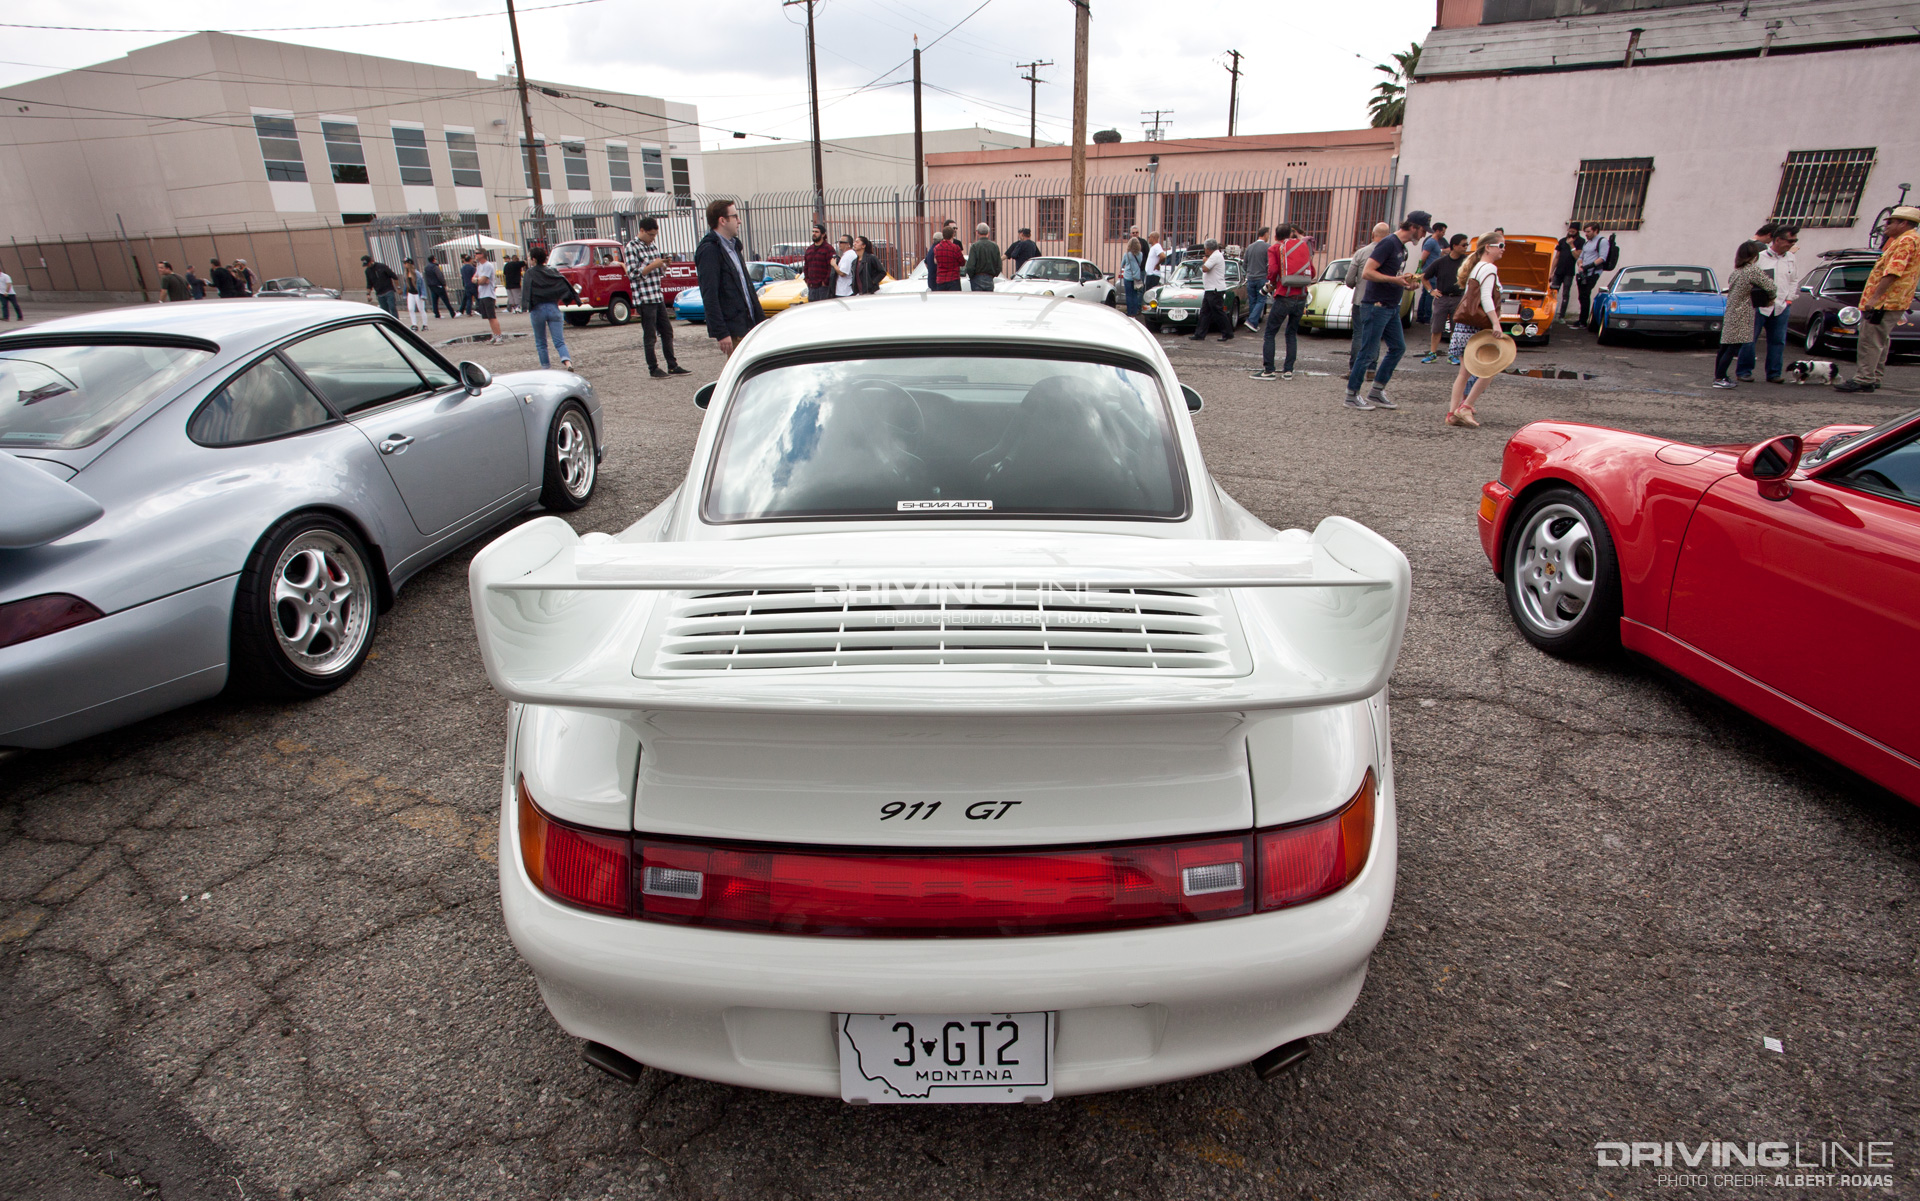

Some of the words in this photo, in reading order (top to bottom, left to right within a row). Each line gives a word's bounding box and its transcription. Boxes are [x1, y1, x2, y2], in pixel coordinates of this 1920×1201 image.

[664, 266, 699, 278] RSCH
[879, 801, 943, 821] 911
[965, 801, 1023, 820] GT
[915, 1069, 1014, 1082] MONTANA
